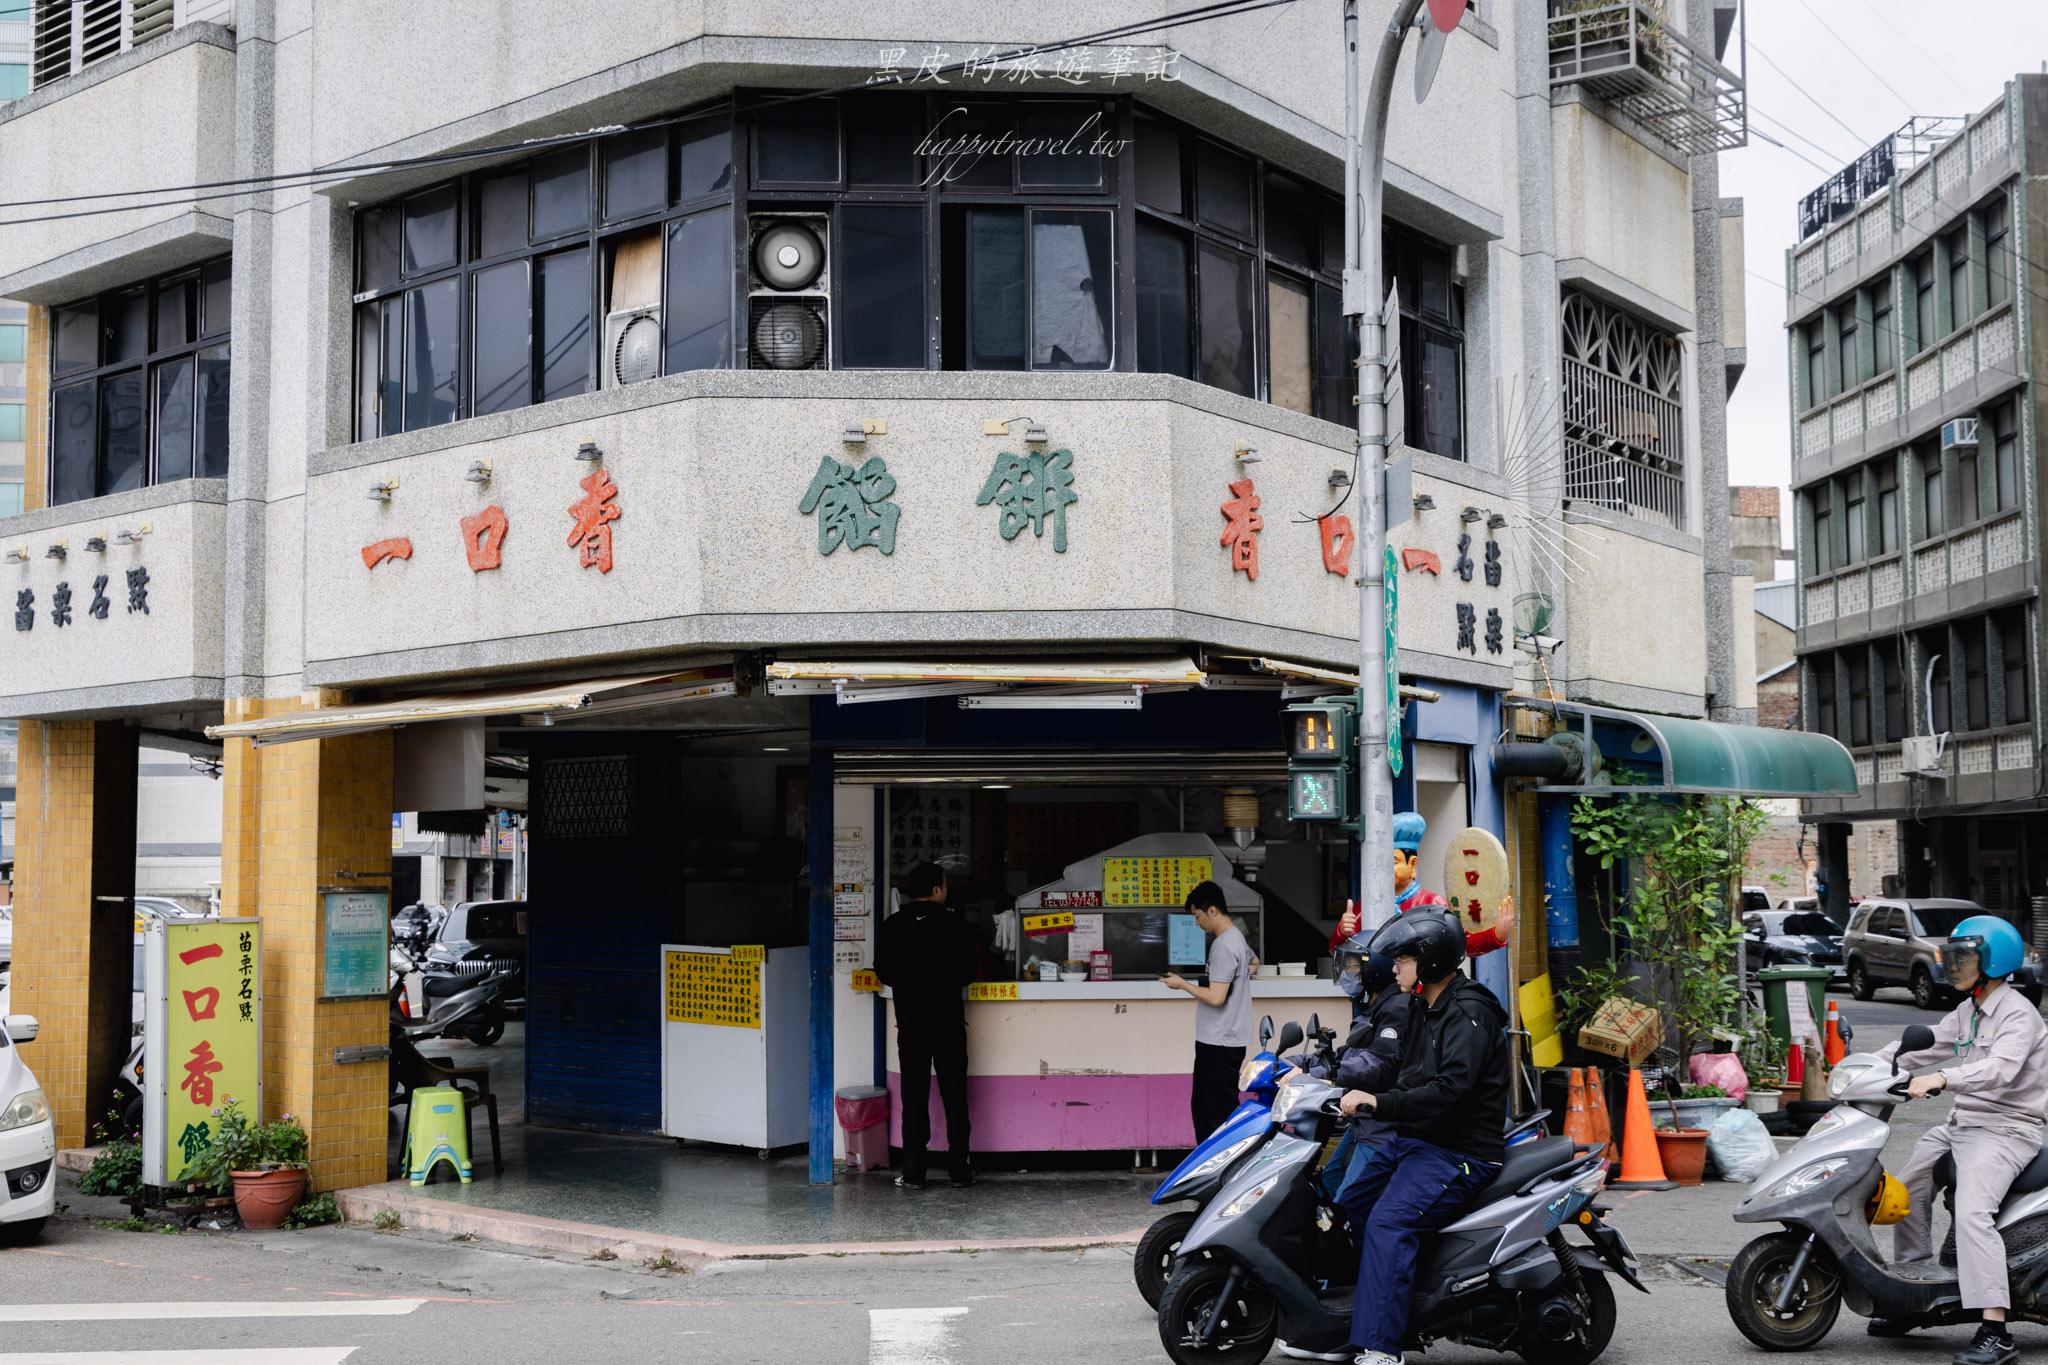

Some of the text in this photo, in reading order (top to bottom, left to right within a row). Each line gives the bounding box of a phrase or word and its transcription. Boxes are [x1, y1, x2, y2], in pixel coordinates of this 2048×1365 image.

[361, 466, 622, 575] 一口香
[799, 448, 1079, 556] 餡餅
[1462, 848, 1482, 923] 一口香
[237, 931, 254, 1023] 苗栗名點
